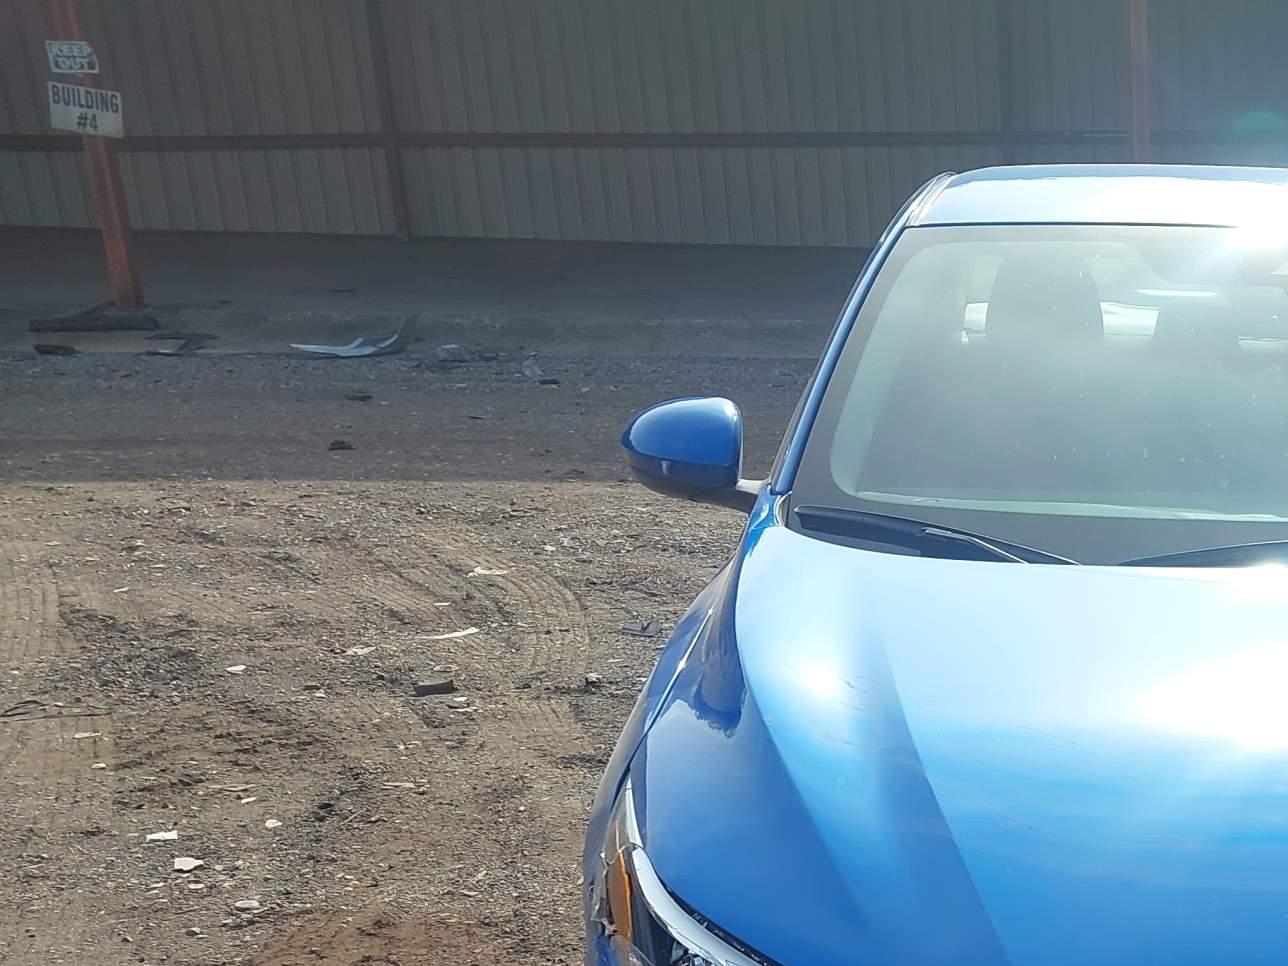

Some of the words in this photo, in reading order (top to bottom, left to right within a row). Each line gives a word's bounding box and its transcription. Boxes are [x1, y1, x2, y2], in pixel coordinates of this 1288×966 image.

[50, 44, 91, 57] KEEP
[57, 57, 89, 70] OUT
[51, 84, 119, 113] BUILDING
[76, 112, 98, 132] #4
